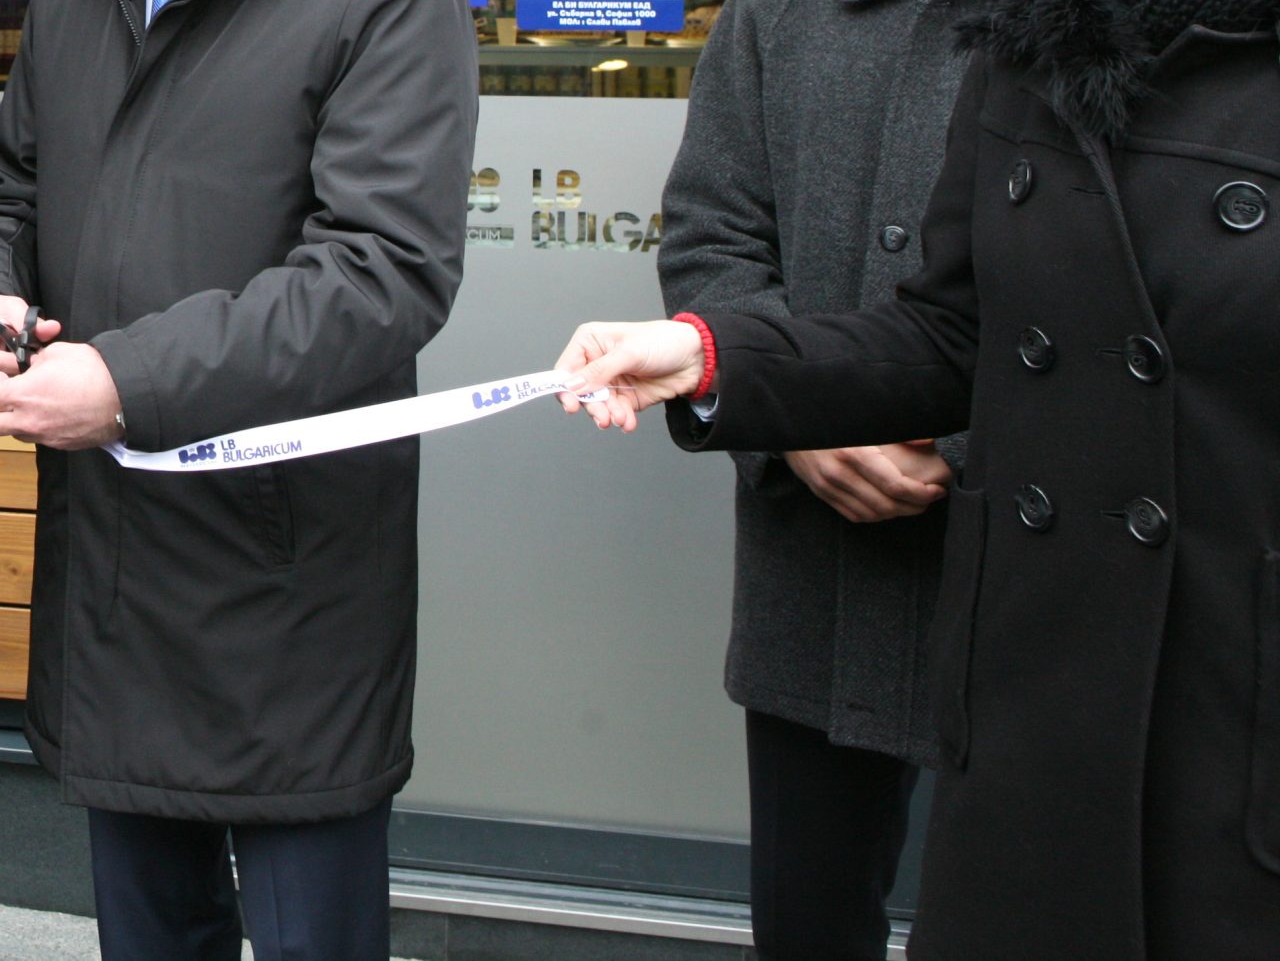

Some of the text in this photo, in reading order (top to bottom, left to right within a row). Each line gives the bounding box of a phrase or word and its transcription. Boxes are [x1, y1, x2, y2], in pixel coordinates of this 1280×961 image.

[532, 169, 582, 208] LB
[531, 211, 663, 252] BULGA
[220, 439, 236, 450] LB
[223, 440, 303, 463] BULGARICUM
